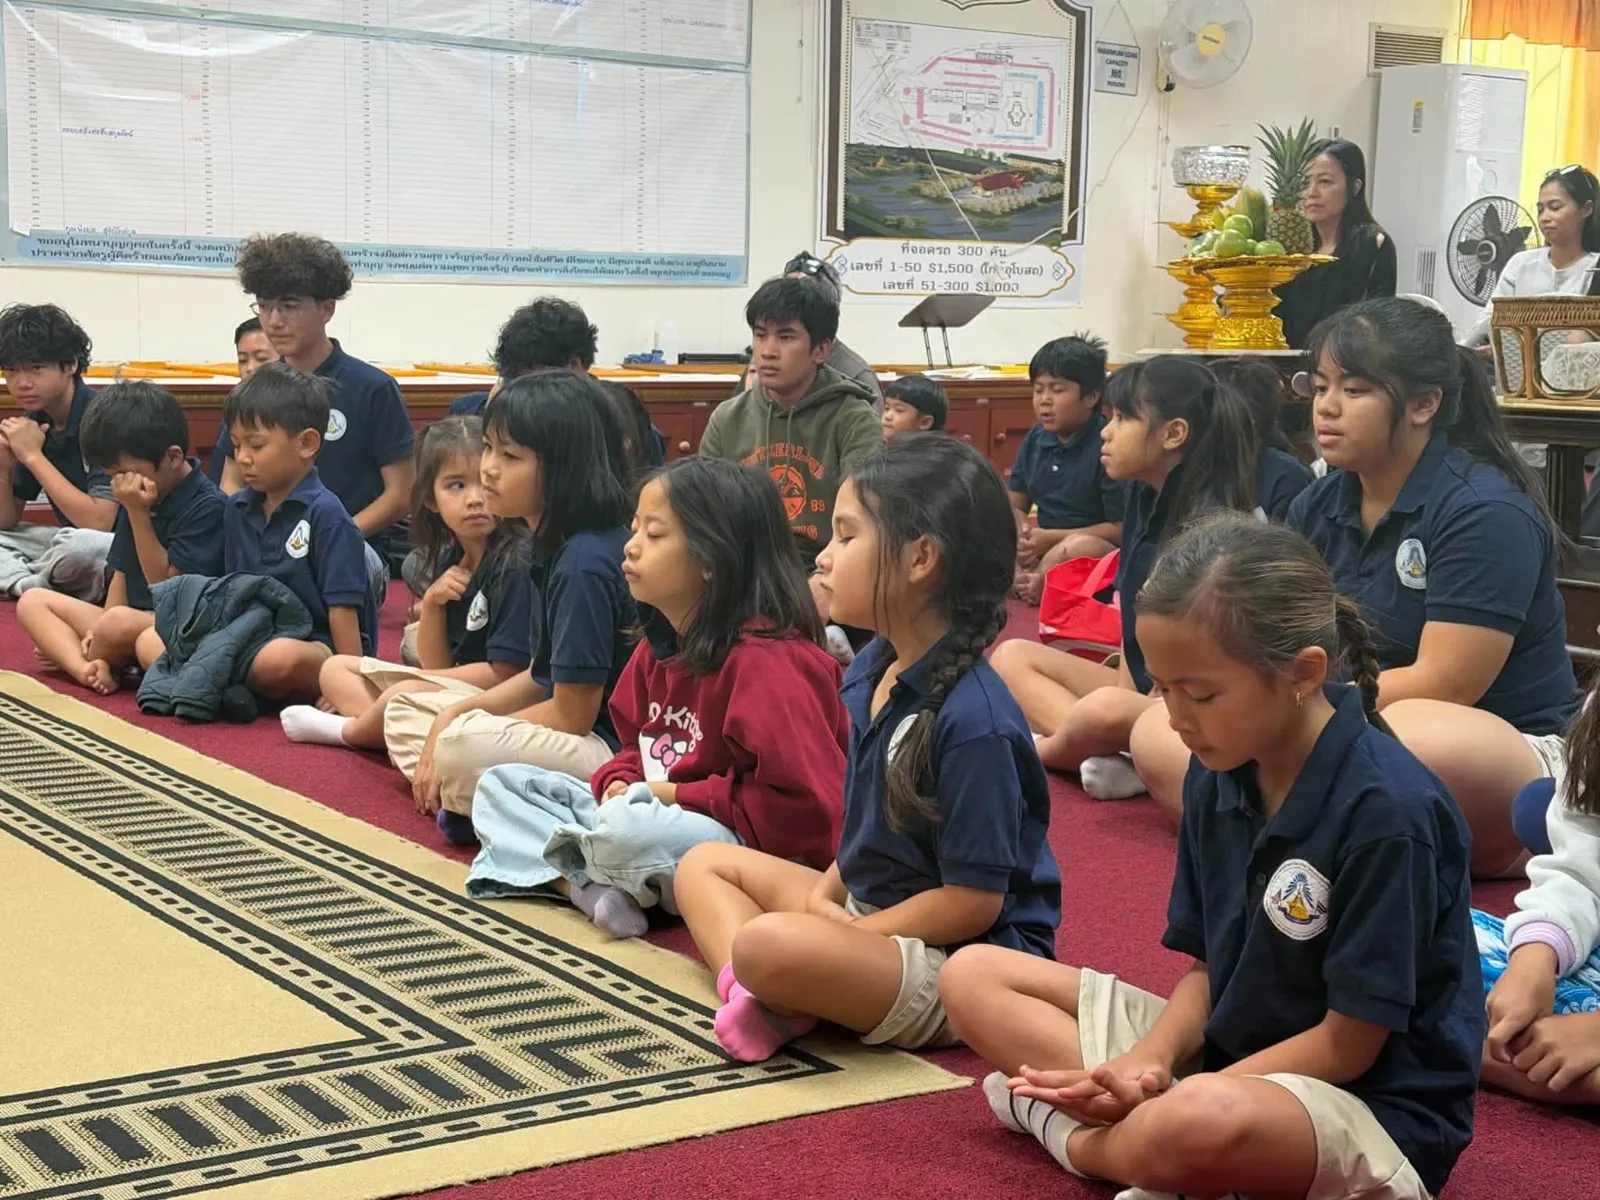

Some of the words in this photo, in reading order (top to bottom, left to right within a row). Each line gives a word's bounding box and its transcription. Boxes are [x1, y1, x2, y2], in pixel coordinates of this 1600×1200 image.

[901, 241, 951, 256] ที่จอดรถ
[957, 245, 984, 257] 300
[989, 246, 1008, 257] คัน
[850, 256, 883, 272] เลขที่
[890, 261, 922, 273] 1-50
[928, 261, 974, 275] $1,500
[883, 276, 914, 291] เลขที่
[921, 281, 969, 293] 51-300
